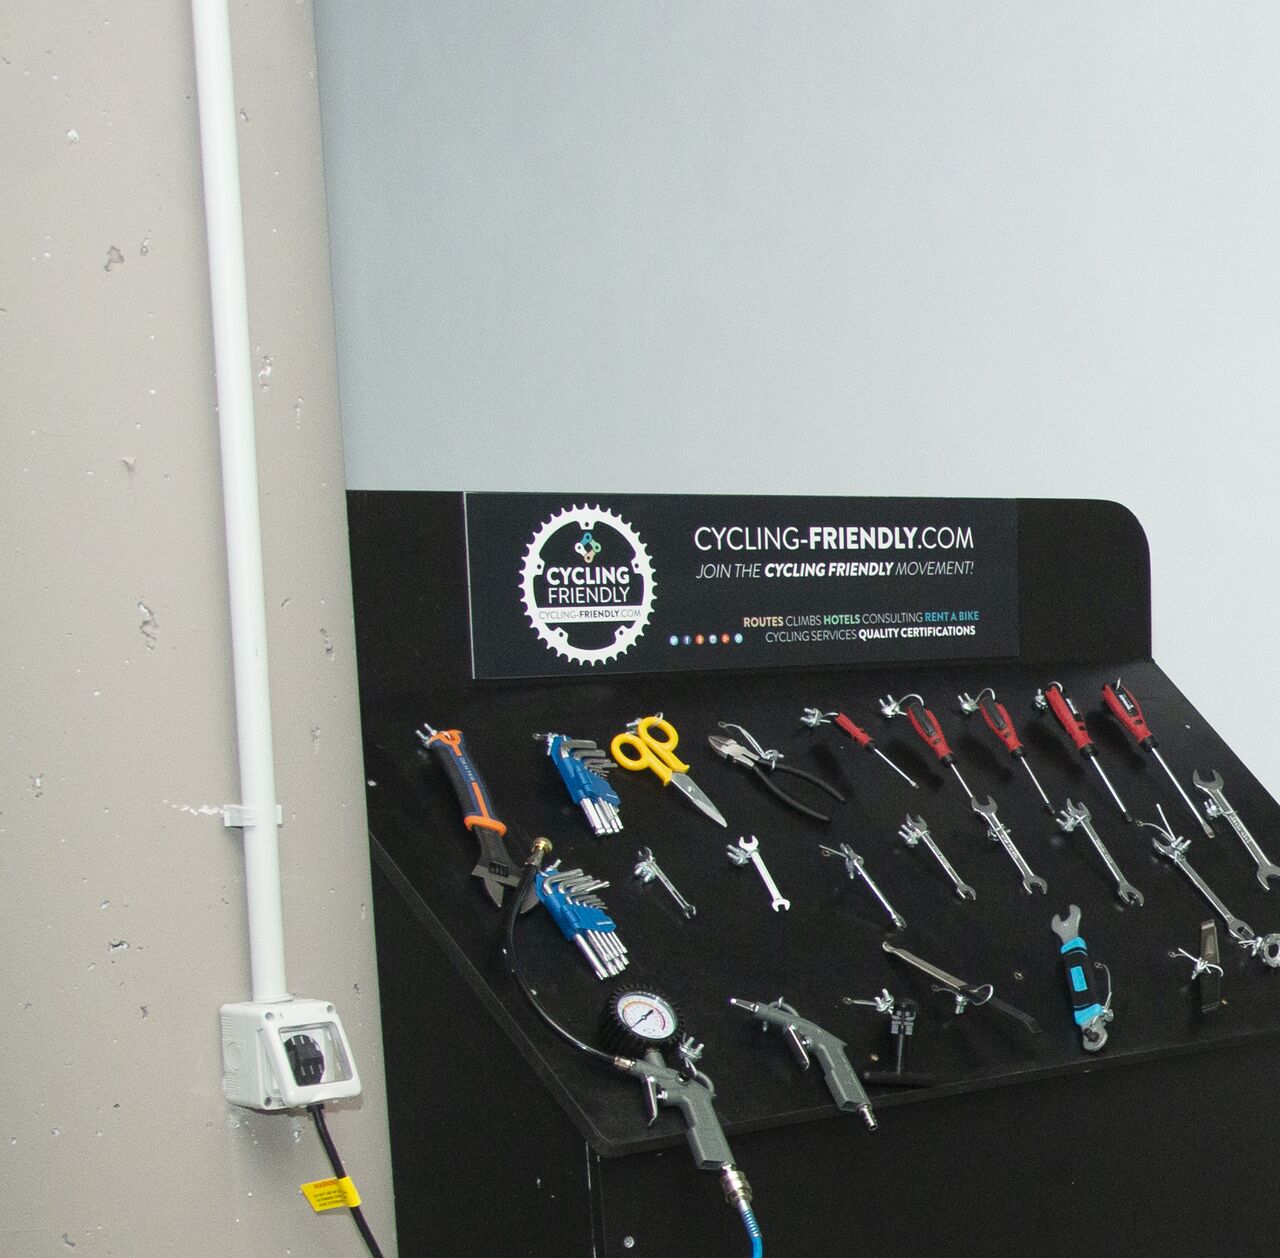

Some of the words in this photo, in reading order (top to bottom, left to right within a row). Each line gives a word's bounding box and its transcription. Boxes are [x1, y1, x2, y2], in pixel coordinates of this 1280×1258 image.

[694, 526, 974, 551] CYCLING-FRIENDLY.COM
[546, 566, 630, 586] CYCLING
[695, 563, 732, 579] JOIN
[734, 563, 761, 578] THE
[764, 562, 826, 578] CYCLING
[828, 561, 894, 577] FRIENDLY
[895, 561, 974, 576] MOVEMENT!
[548, 586, 630, 604] FRIENDLY
[539, 609, 641, 620] CYCLING-FRIENDLY.COM
[743, 616, 784, 628] ROUTES
[785, 615, 822, 627] CLIMBS
[823, 614, 861, 626] HOTELS
[862, 612, 923, 624] CONSULTING
[924, 611, 950, 622] RENT
[950, 611, 958, 622] A
[958, 610, 980, 621] BIKE
[765, 631, 810, 643] CYCLING
[811, 629, 857, 642] SERVICES
[858, 627, 900, 642] QUALITY
[900, 625, 976, 639] CERTIFICATIONS
